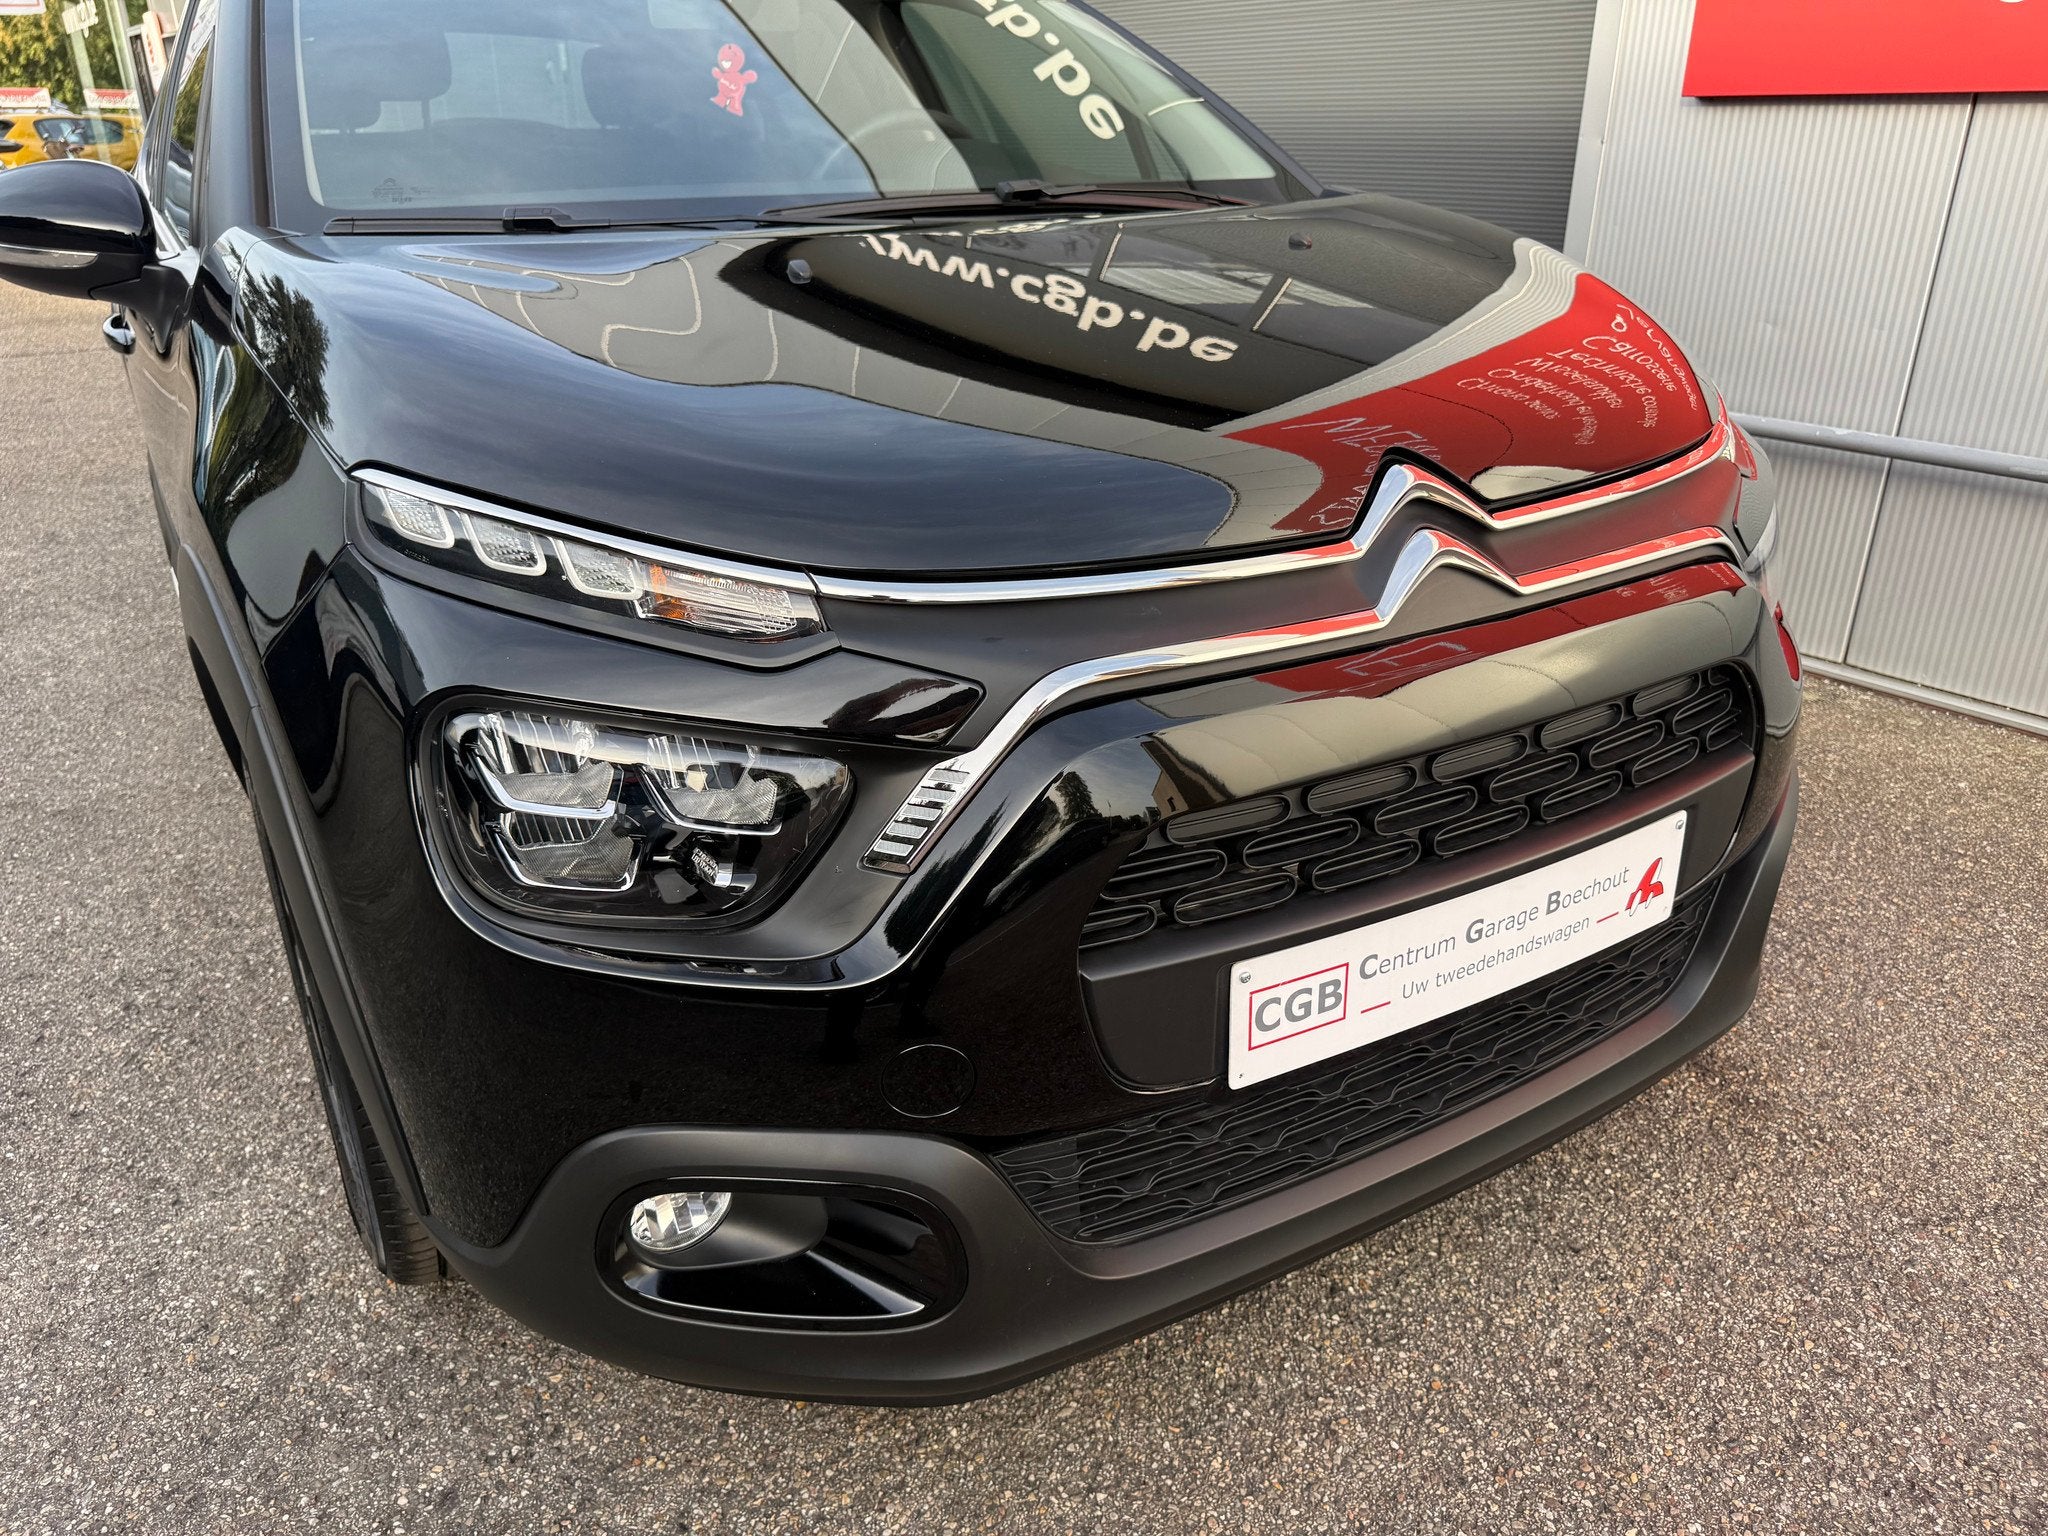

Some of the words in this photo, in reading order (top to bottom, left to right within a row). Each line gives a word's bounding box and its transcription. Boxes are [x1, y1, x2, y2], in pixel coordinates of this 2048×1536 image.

[1359, 935, 1456, 980] Centrum
[1465, 906, 1539, 944] Garage
[1545, 866, 1630, 916] Boechout
[1401, 975, 1431, 1000] Uw
[1435, 916, 1590, 988] tweedehandswagen
[1254, 978, 1344, 1033] CGB
